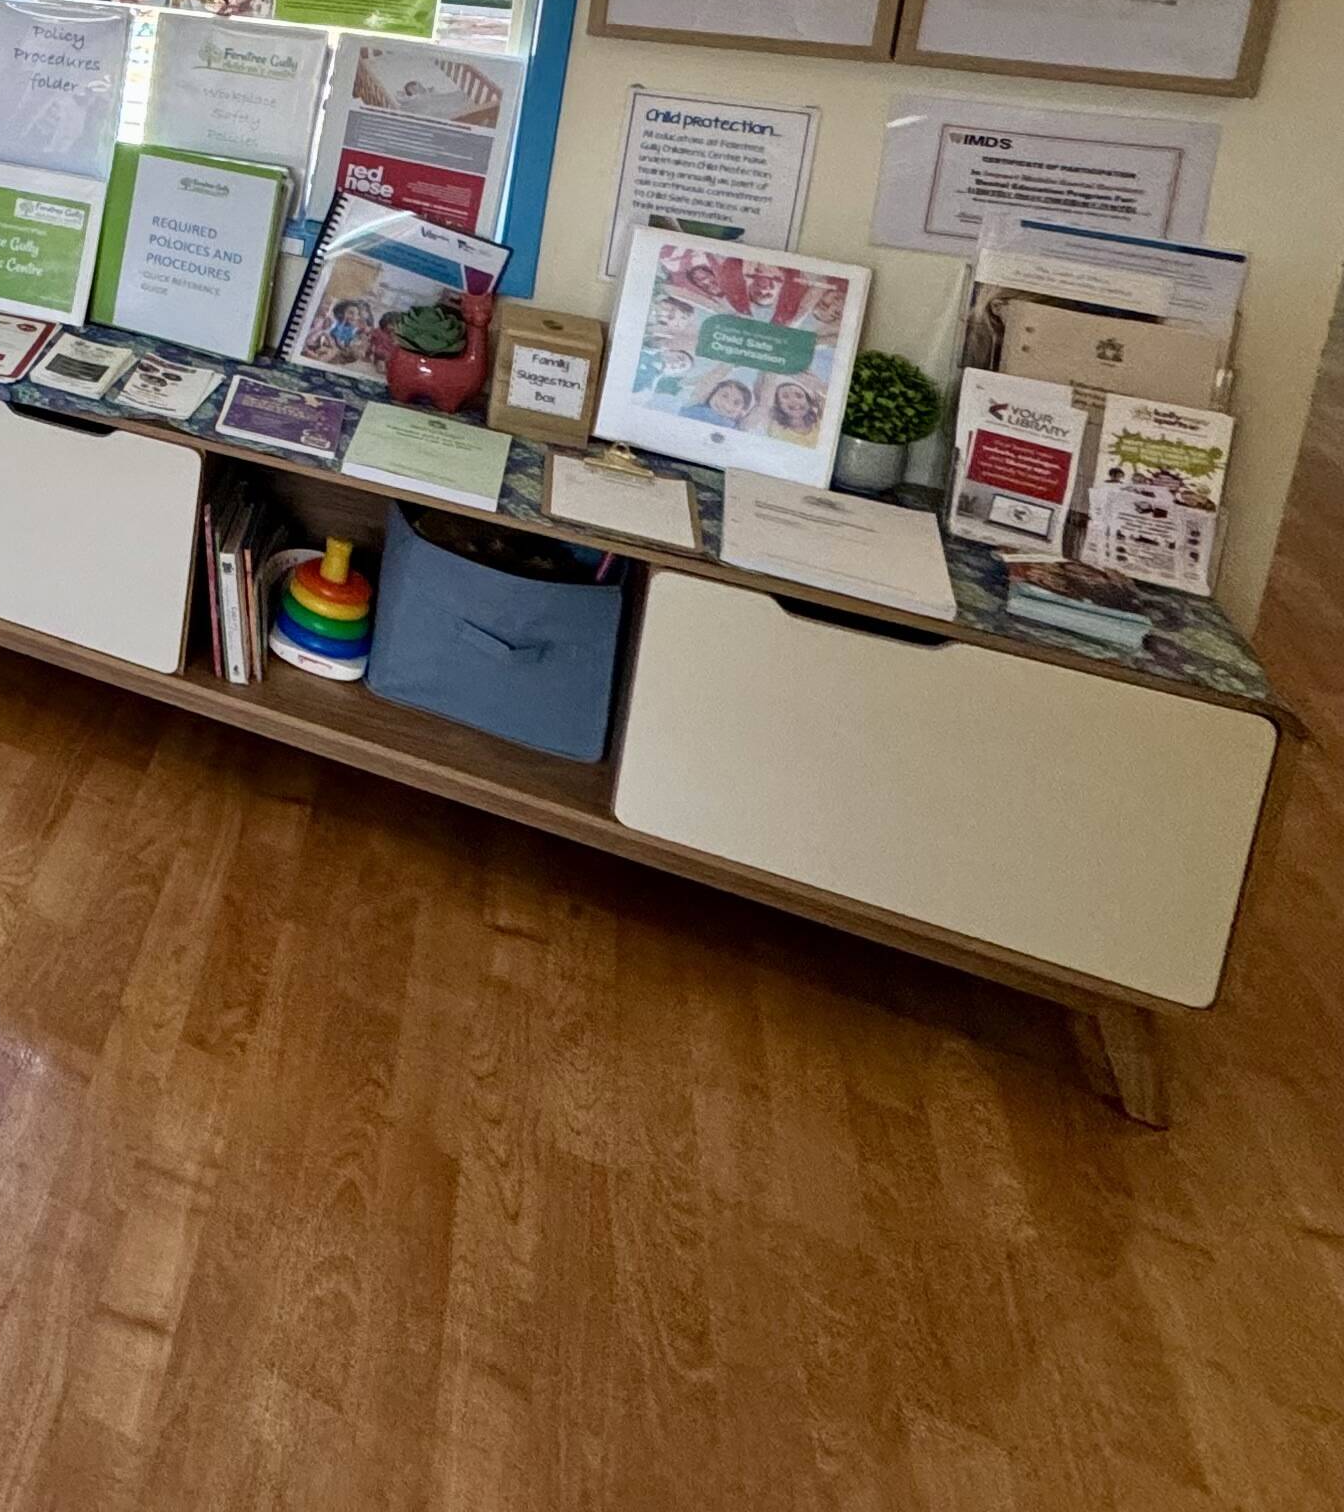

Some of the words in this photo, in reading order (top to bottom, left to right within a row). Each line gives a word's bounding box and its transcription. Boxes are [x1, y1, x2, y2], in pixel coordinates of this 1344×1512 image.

[33, 25, 85, 49] Policy
[14, 47, 100, 70] Procedures
[224, 48, 267, 64] Ferntree
[271, 55, 297, 73] Gully
[646, 109, 681, 125] Child
[963, 134, 1013, 150] IMDS
[348, 163, 384, 182] red
[345, 175, 394, 198] nose
[152, 216, 217, 239] REQUIRED
[10, 237, 40, 258] Gully
[149, 234, 210, 257] POLOICES
[213, 248, 243, 265] AND
[6, 257, 43, 277] Centre
[146, 252, 231, 281] PROCEDURES
[713, 331, 743, 345] Child
[745, 338, 773, 351] Safe
[532, 354, 569, 373] Family
[517, 369, 581, 390] suggestion
[535, 391, 555, 404] Box
[1012, 406, 1054, 424] YOUR
[1008, 416, 1070, 438] LIBRARY
